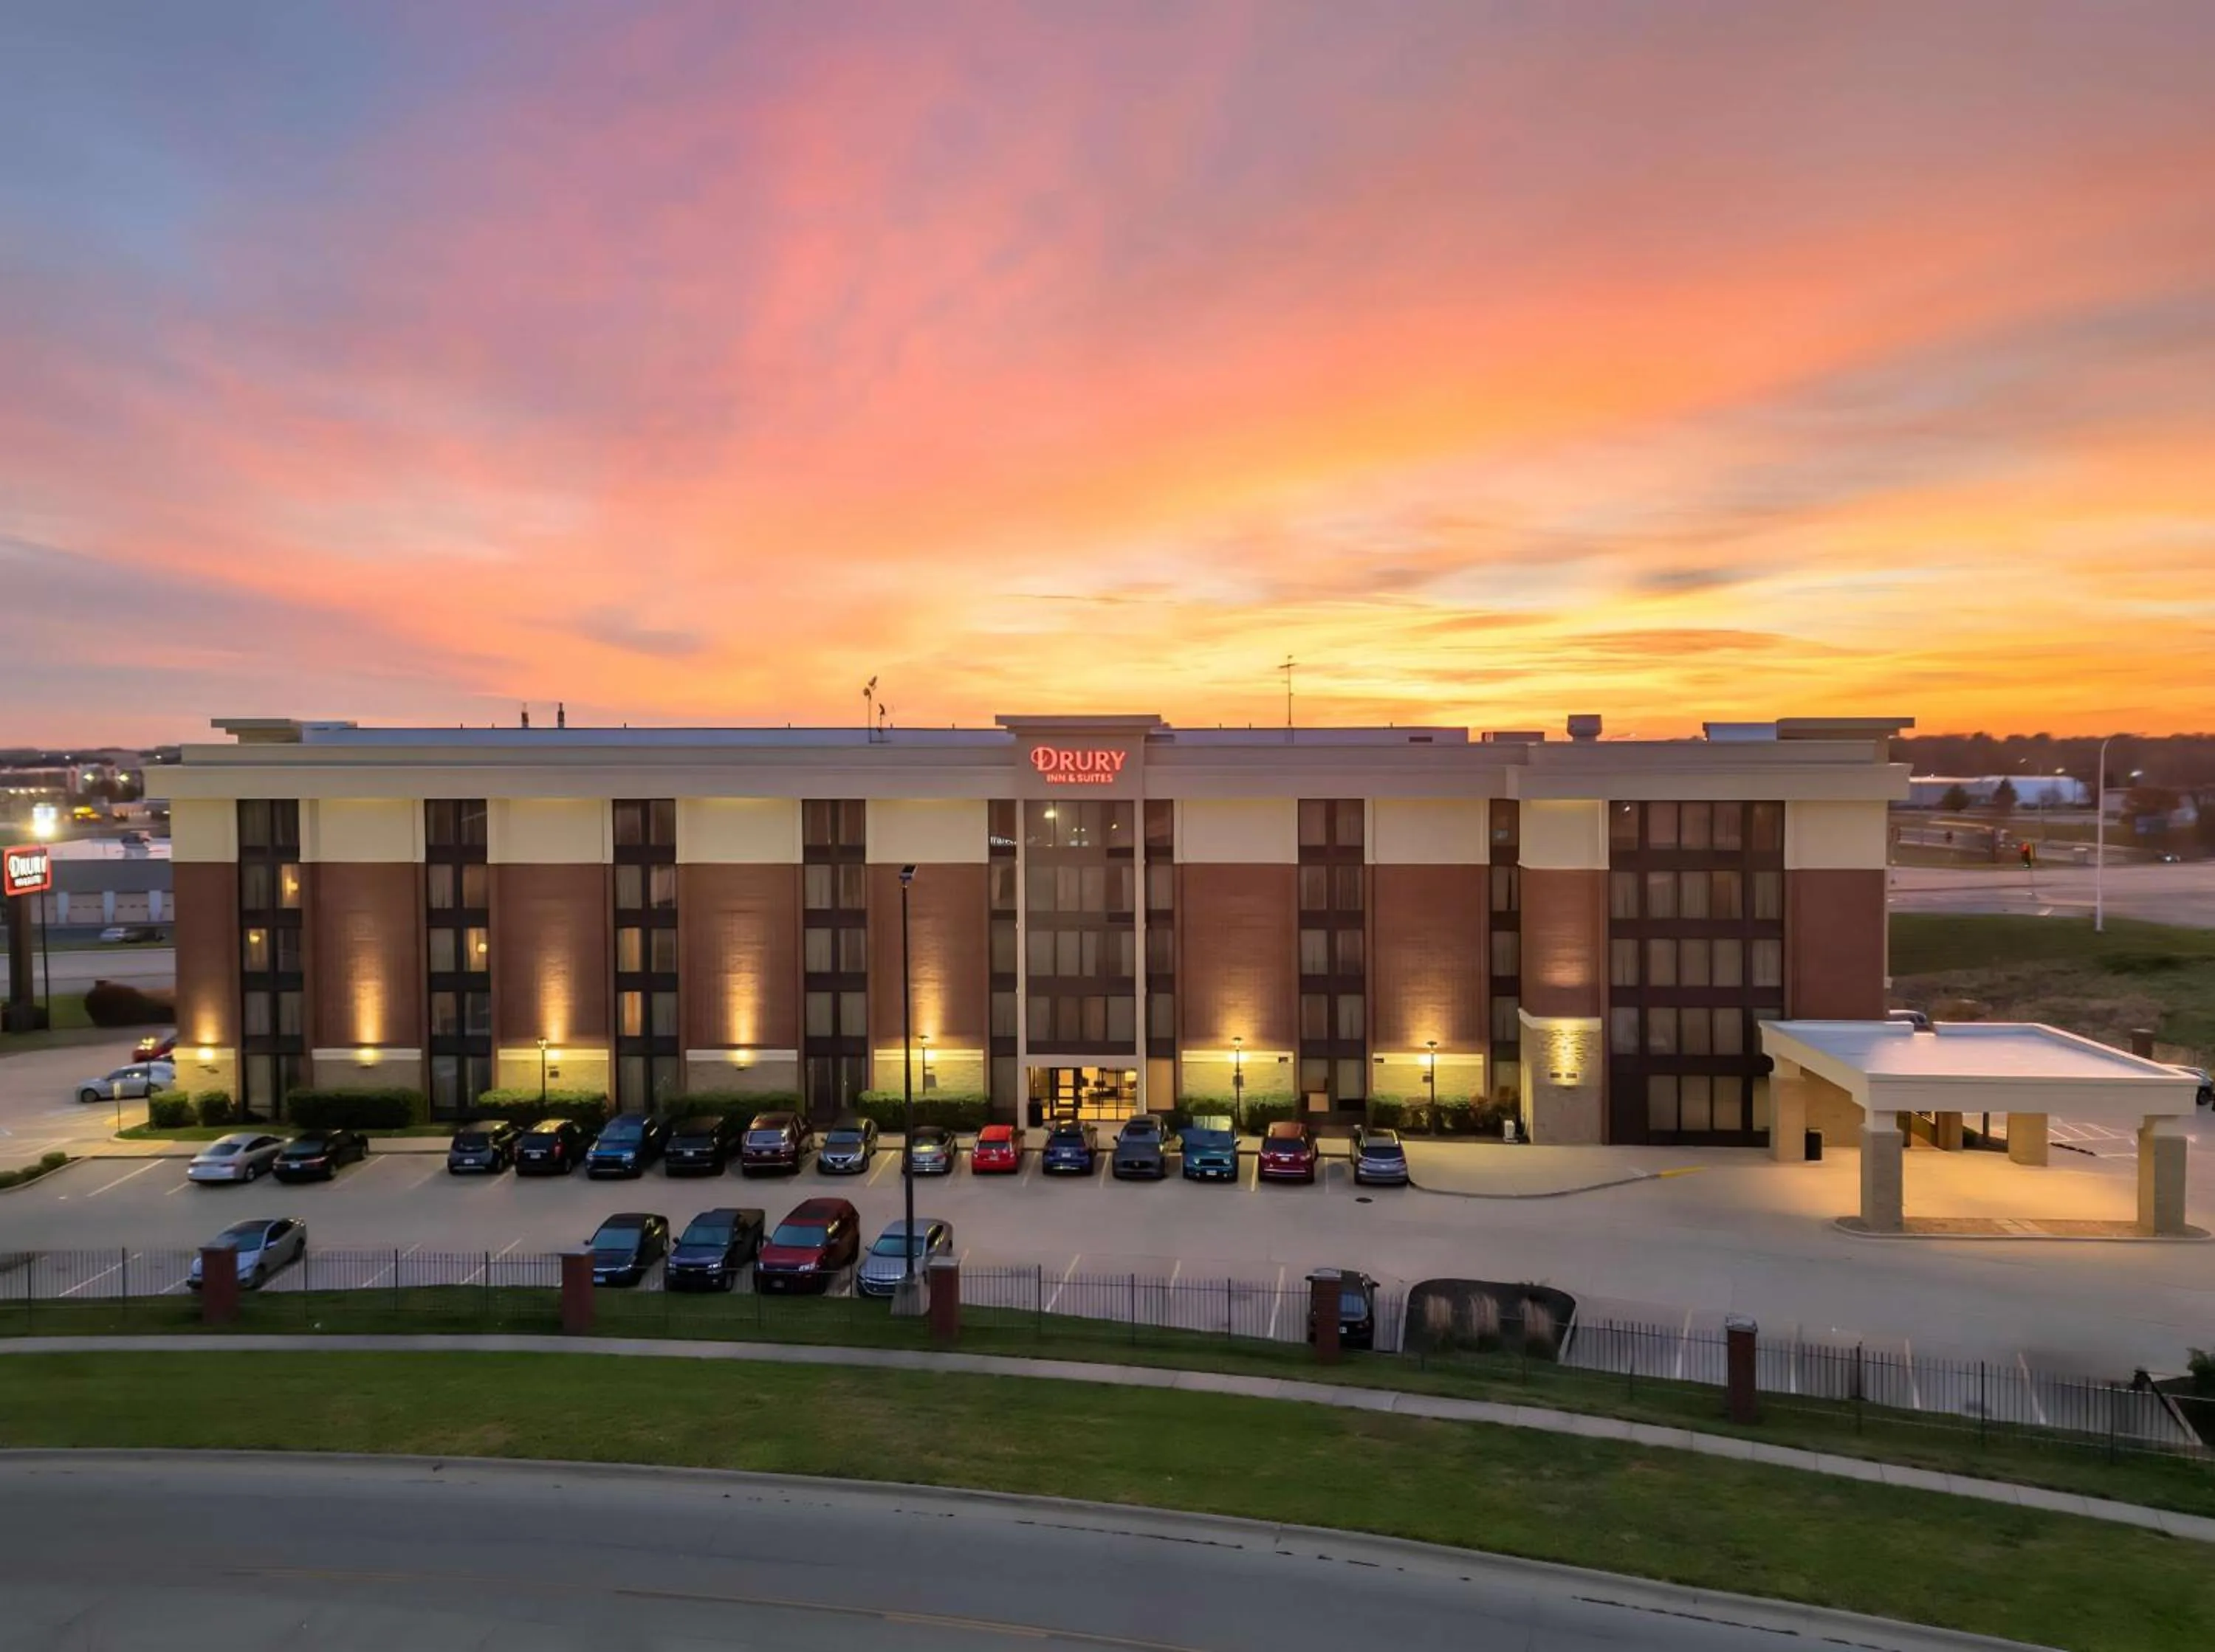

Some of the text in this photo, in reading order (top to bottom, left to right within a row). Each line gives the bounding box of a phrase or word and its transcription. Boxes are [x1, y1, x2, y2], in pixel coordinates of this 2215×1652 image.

[1031, 746, 1126, 771] DRURY
[1046, 774, 1113, 783] INN & SUITES
